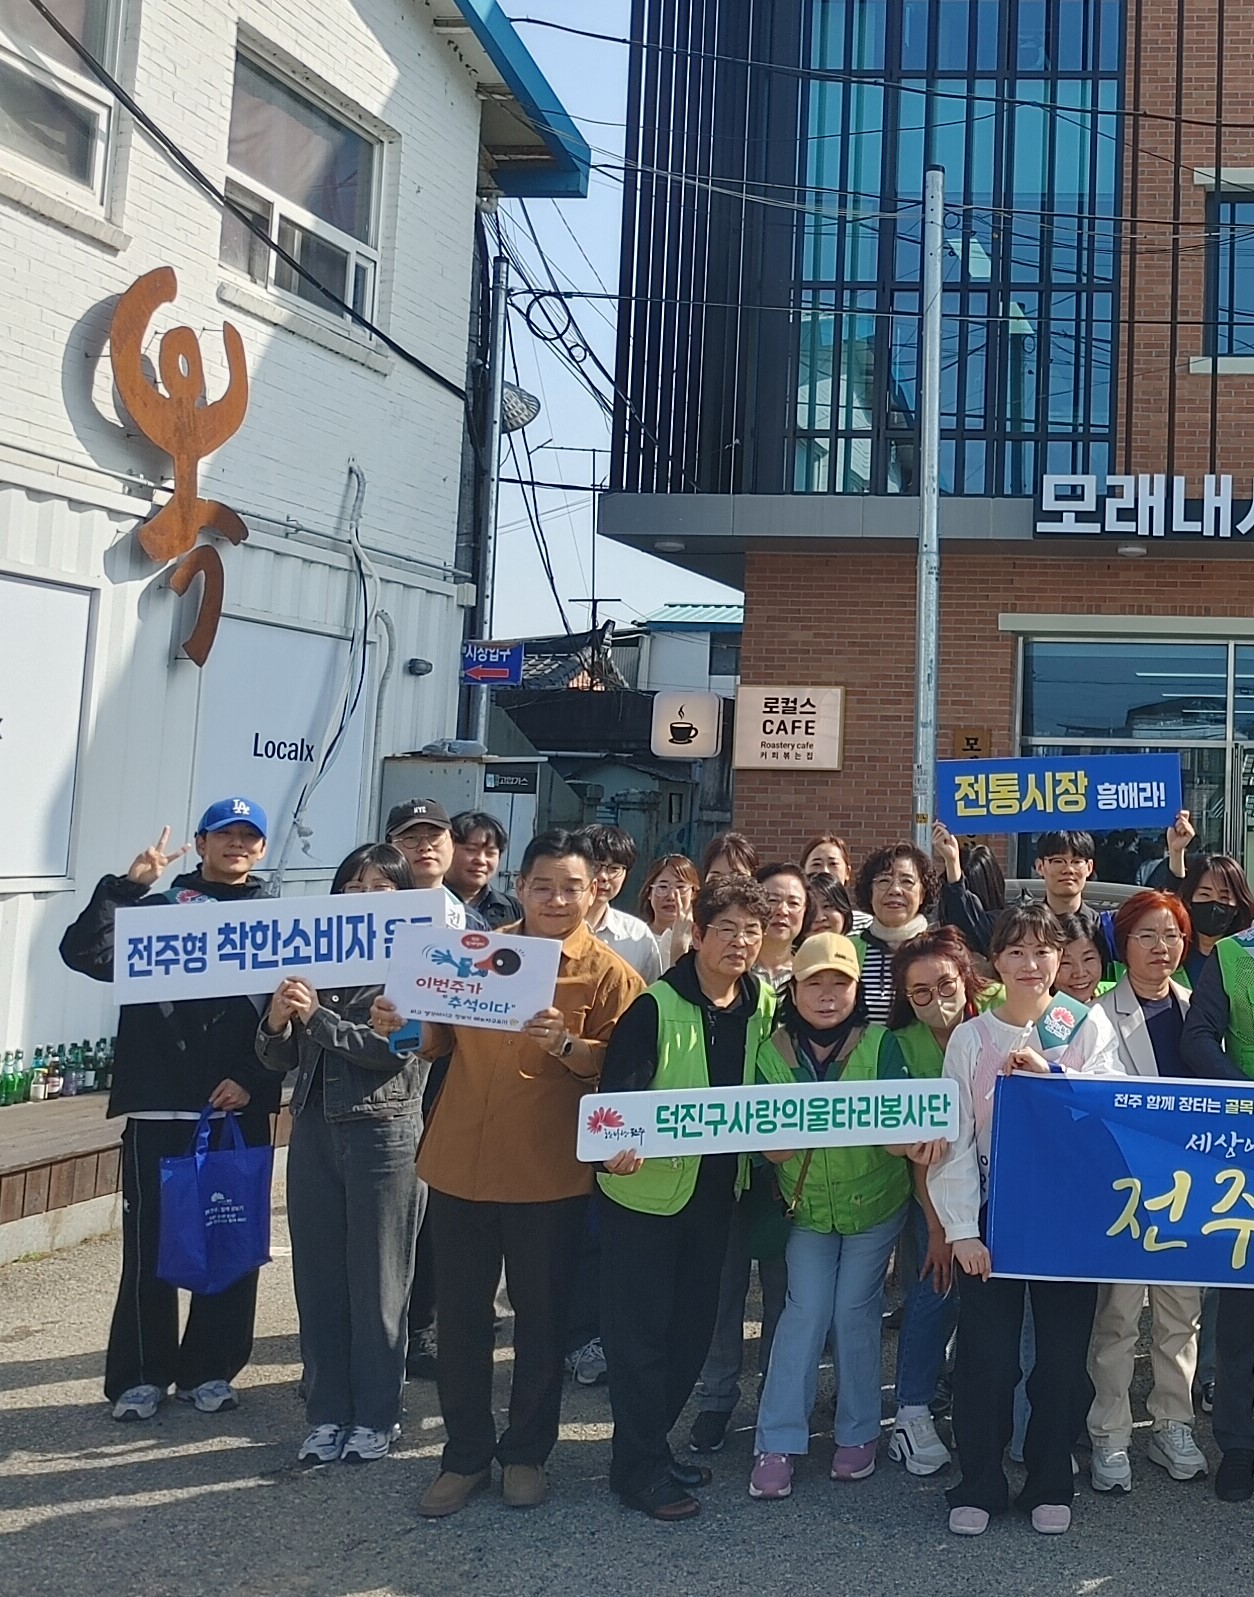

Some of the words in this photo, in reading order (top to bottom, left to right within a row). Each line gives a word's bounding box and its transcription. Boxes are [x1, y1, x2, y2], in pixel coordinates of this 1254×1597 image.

[762, 697, 817, 715] 로컬스
[762, 719, 816, 736] CAFE
[252, 732, 315, 763] Localx
[760, 741, 796, 750] Roastery
[796, 741, 814, 749] cafe
[954, 770, 1089, 817] 전통시장
[1096, 782, 1166, 810] 흥해라!
[232, 799, 250, 815] LA
[127, 932, 209, 979] 전주형
[217, 912, 377, 971] 착한소비자
[416, 976, 483, 995] 이번주가
[1114, 1093, 1143, 1110] 전주
[1146, 1095, 1175, 1112] 함께
[1178, 1097, 1221, 1114] 장터는
[655, 1092, 951, 1140] 덕진구사랑의울타리봉사단
